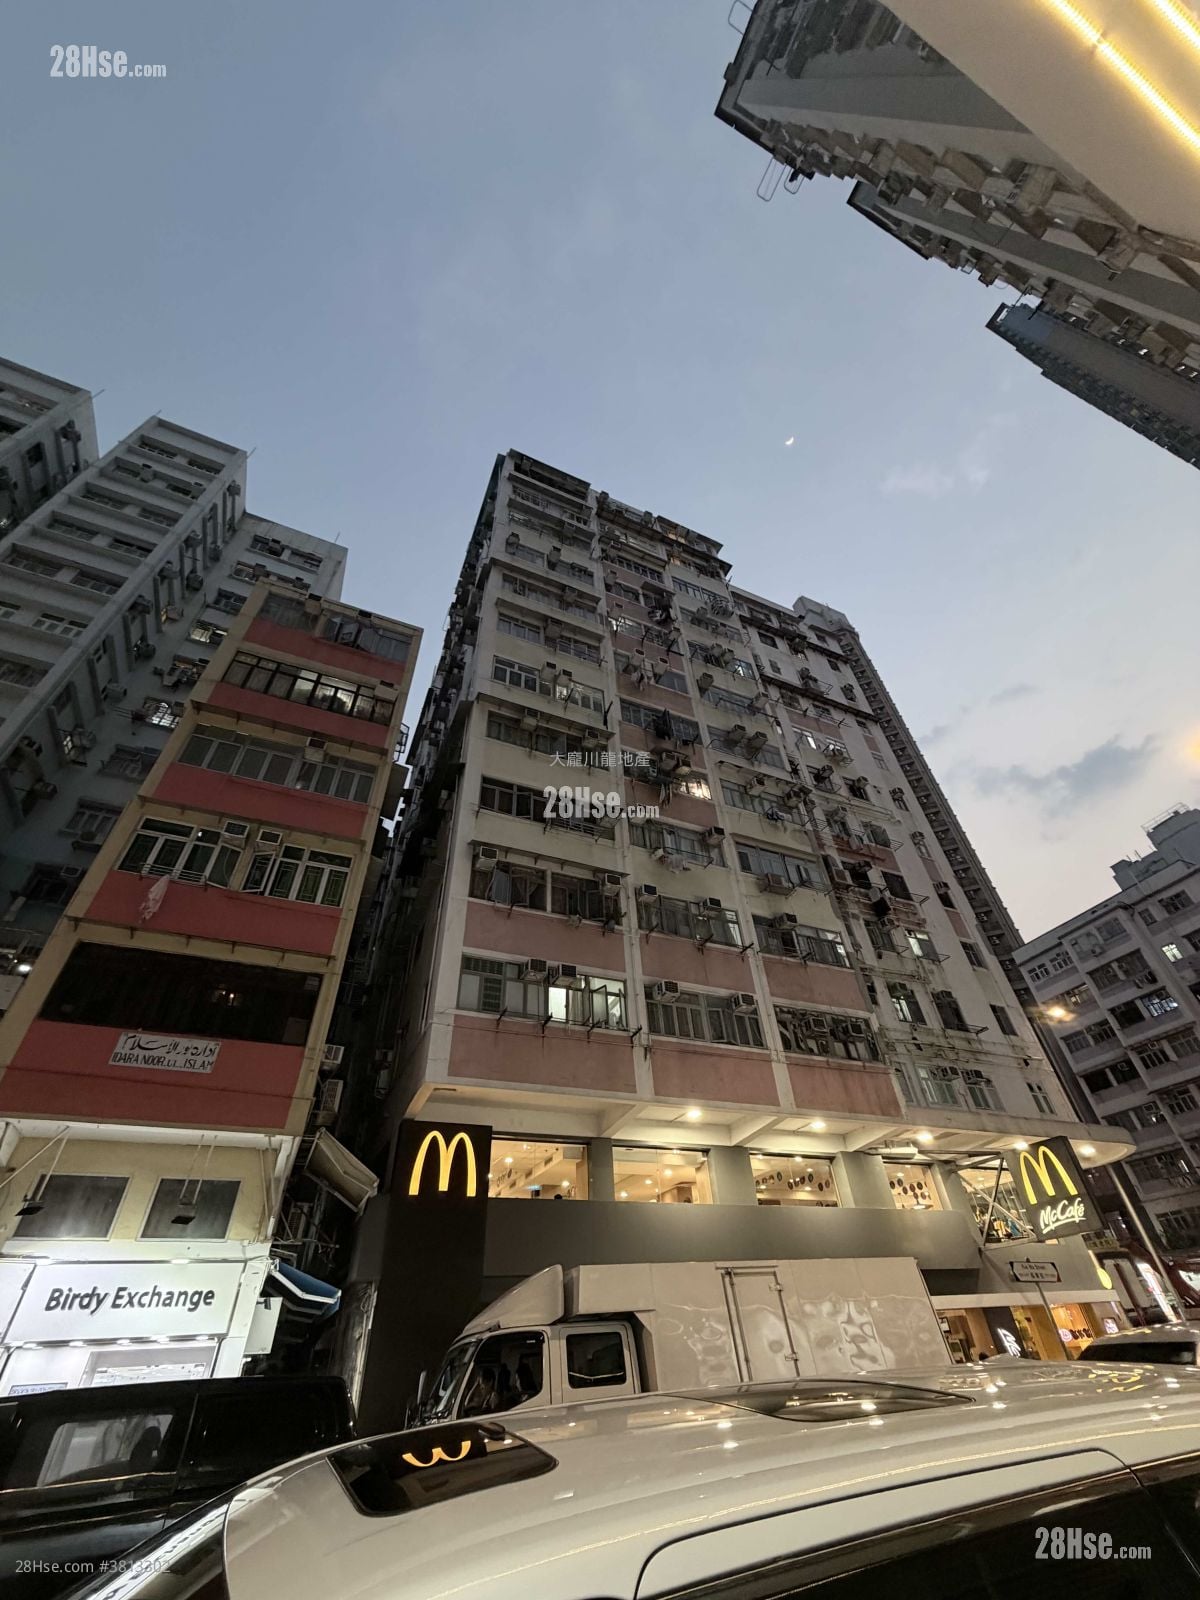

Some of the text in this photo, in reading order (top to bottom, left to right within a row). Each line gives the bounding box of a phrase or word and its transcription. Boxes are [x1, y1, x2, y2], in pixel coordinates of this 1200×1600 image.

[1039, 1197, 1086, 1232] McCafé
[44, 1285, 215, 1316] Birdy Exchange
